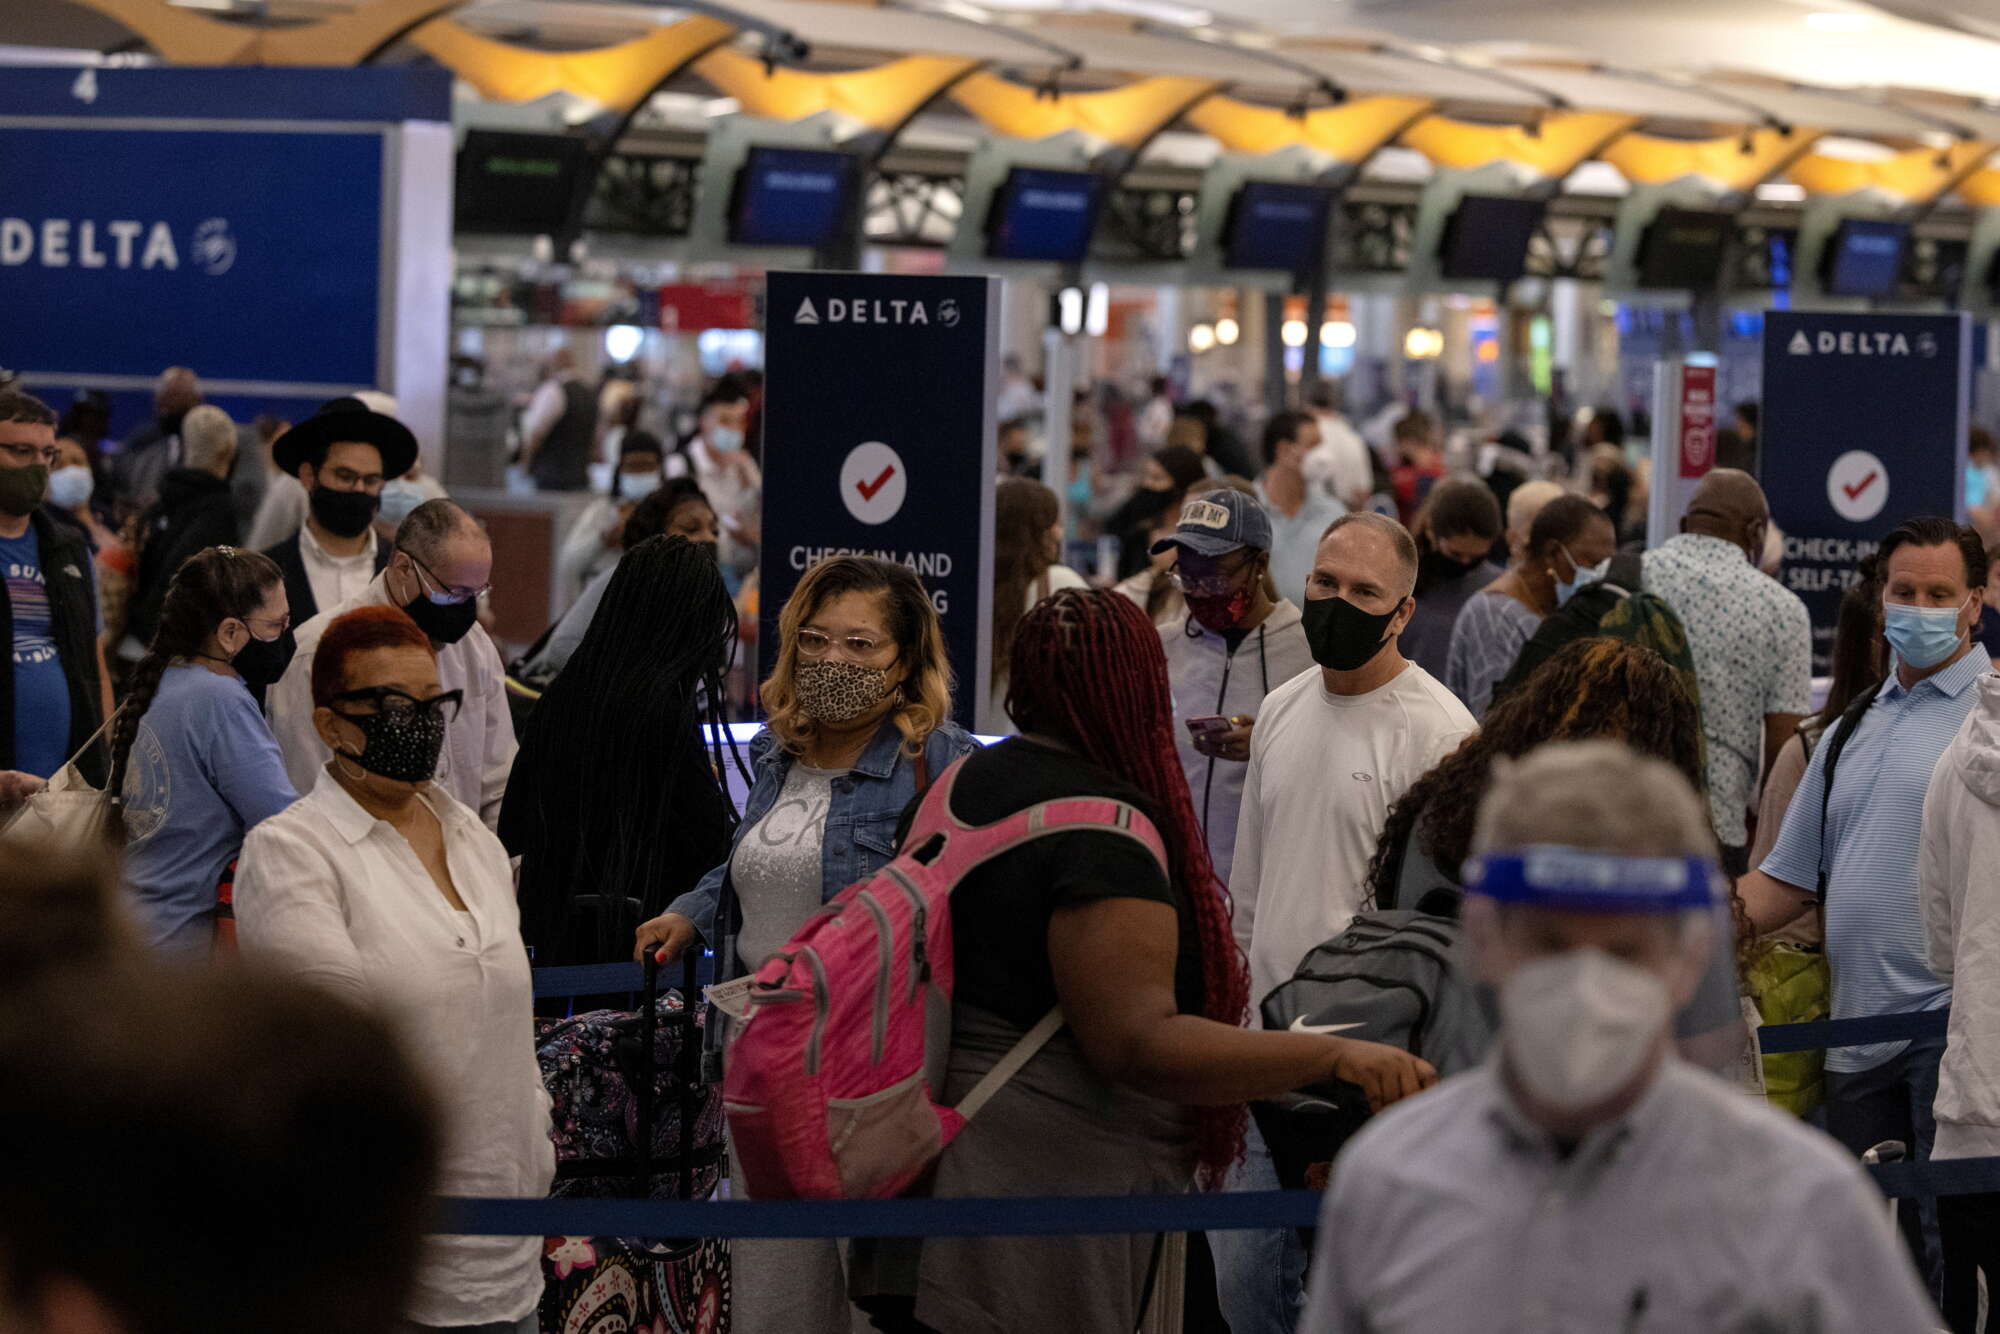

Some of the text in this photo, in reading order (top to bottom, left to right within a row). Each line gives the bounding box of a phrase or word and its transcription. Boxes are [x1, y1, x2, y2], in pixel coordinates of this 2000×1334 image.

[71, 67, 99, 104] 4
[0, 216, 180, 270] DELTA
[827, 298, 929, 325] DELTA
[1816, 330, 1911, 356] DELTA
[903, 551, 953, 577] AND
